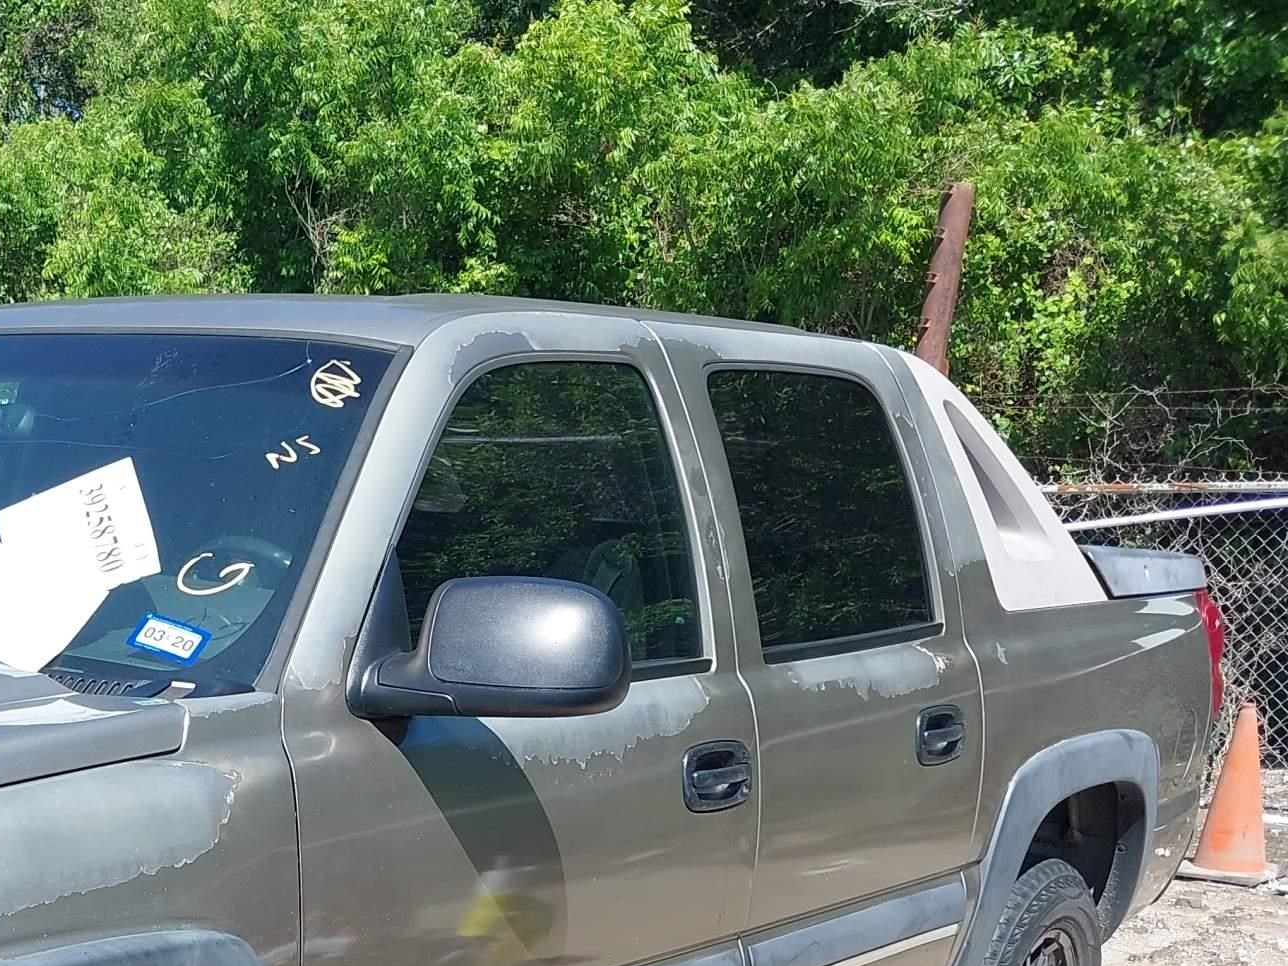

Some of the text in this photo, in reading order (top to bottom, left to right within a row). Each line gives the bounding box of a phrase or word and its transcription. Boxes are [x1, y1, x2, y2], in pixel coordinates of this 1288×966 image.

[79, 483, 125, 573] 39258780
[143, 626, 166, 642] 03
[171, 635, 195, 652] 20
